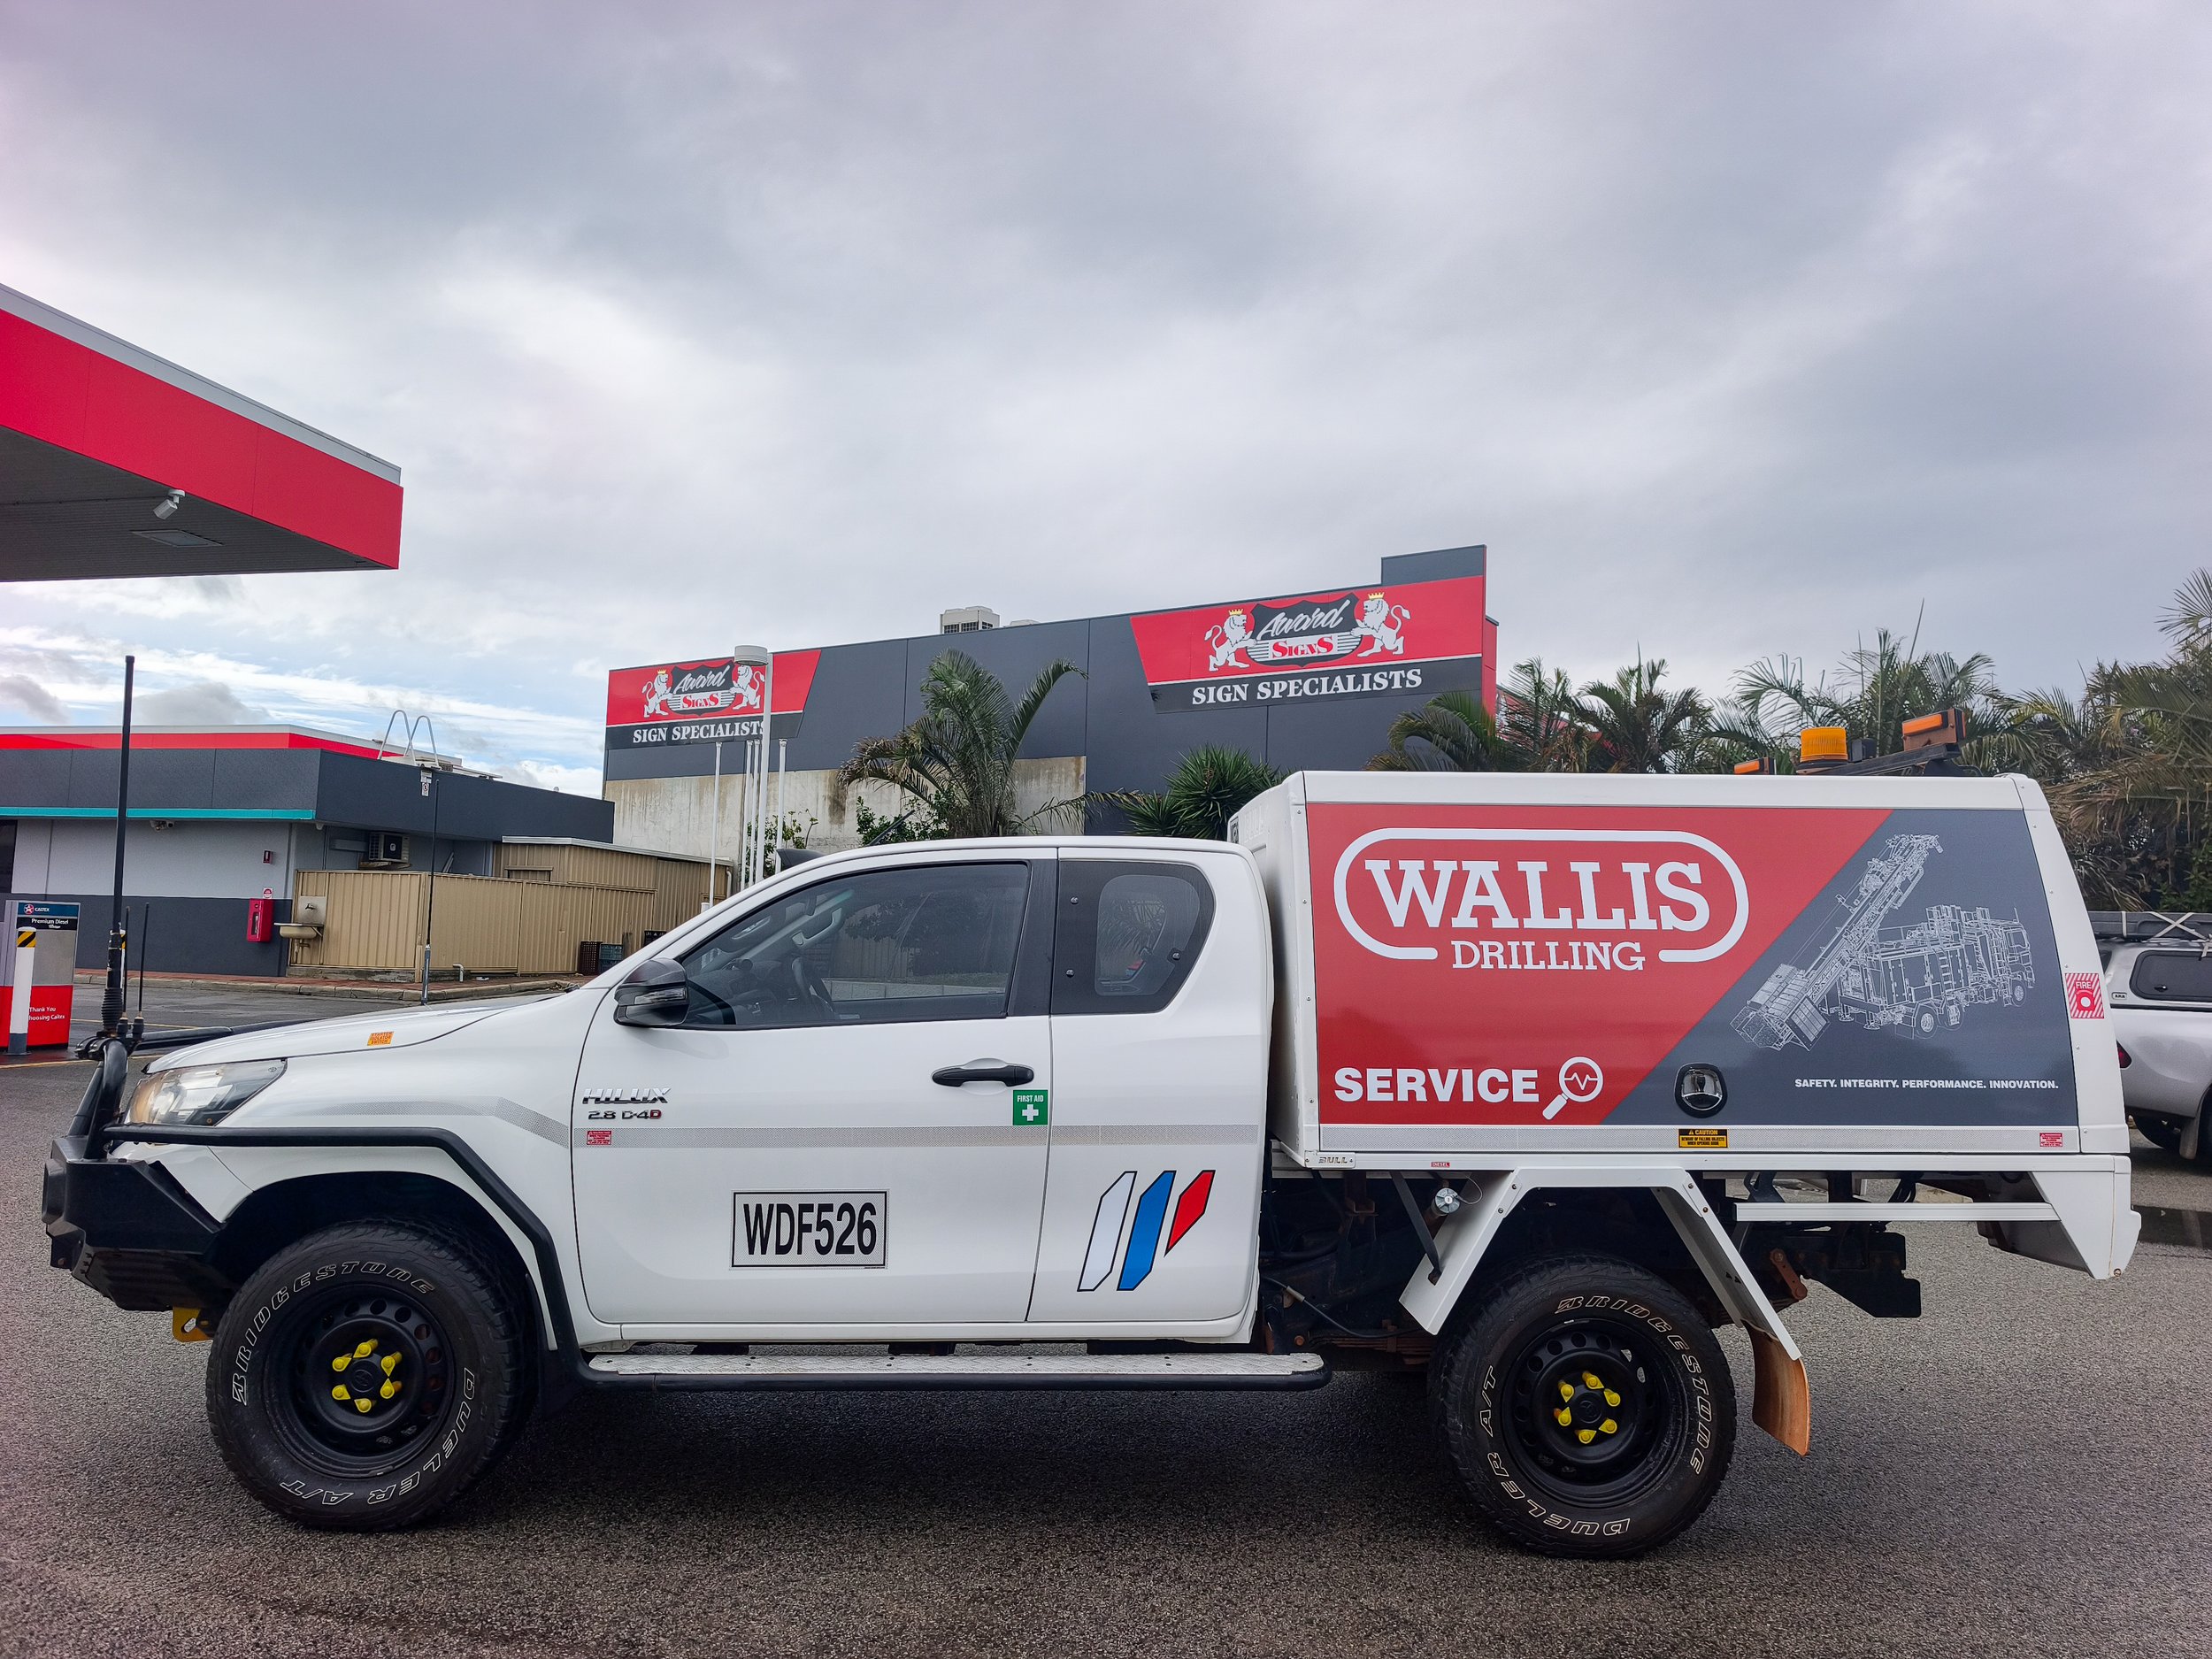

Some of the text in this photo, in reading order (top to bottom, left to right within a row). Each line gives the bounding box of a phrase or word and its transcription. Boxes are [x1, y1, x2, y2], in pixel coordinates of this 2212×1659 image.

[1256, 599, 1351, 640] Award
[673, 664, 730, 694] Award
[1192, 668, 1423, 705] SIGN SPECIALISTS
[633, 727, 668, 743] SIGN
[1365, 859, 1710, 932] WALLIS
[1451, 941, 1646, 971] DRILLING
[582, 1088, 671, 1104] HILUX
[1334, 1068, 1540, 1102] SERVICE
[1794, 1079, 2059, 1089] SAFETY. INTEGRITY. PERFORMANCE. INNOVATION.
[743, 1202, 877, 1256] WDF526
[232, 1261, 435, 1406] BRIDGESTONE
[1555, 1295, 1712, 1475] BRIDGESTONE
[280, 1368, 475, 1505] DUELER A/T
[1479, 1365, 1631, 1536] DUELER A/T
